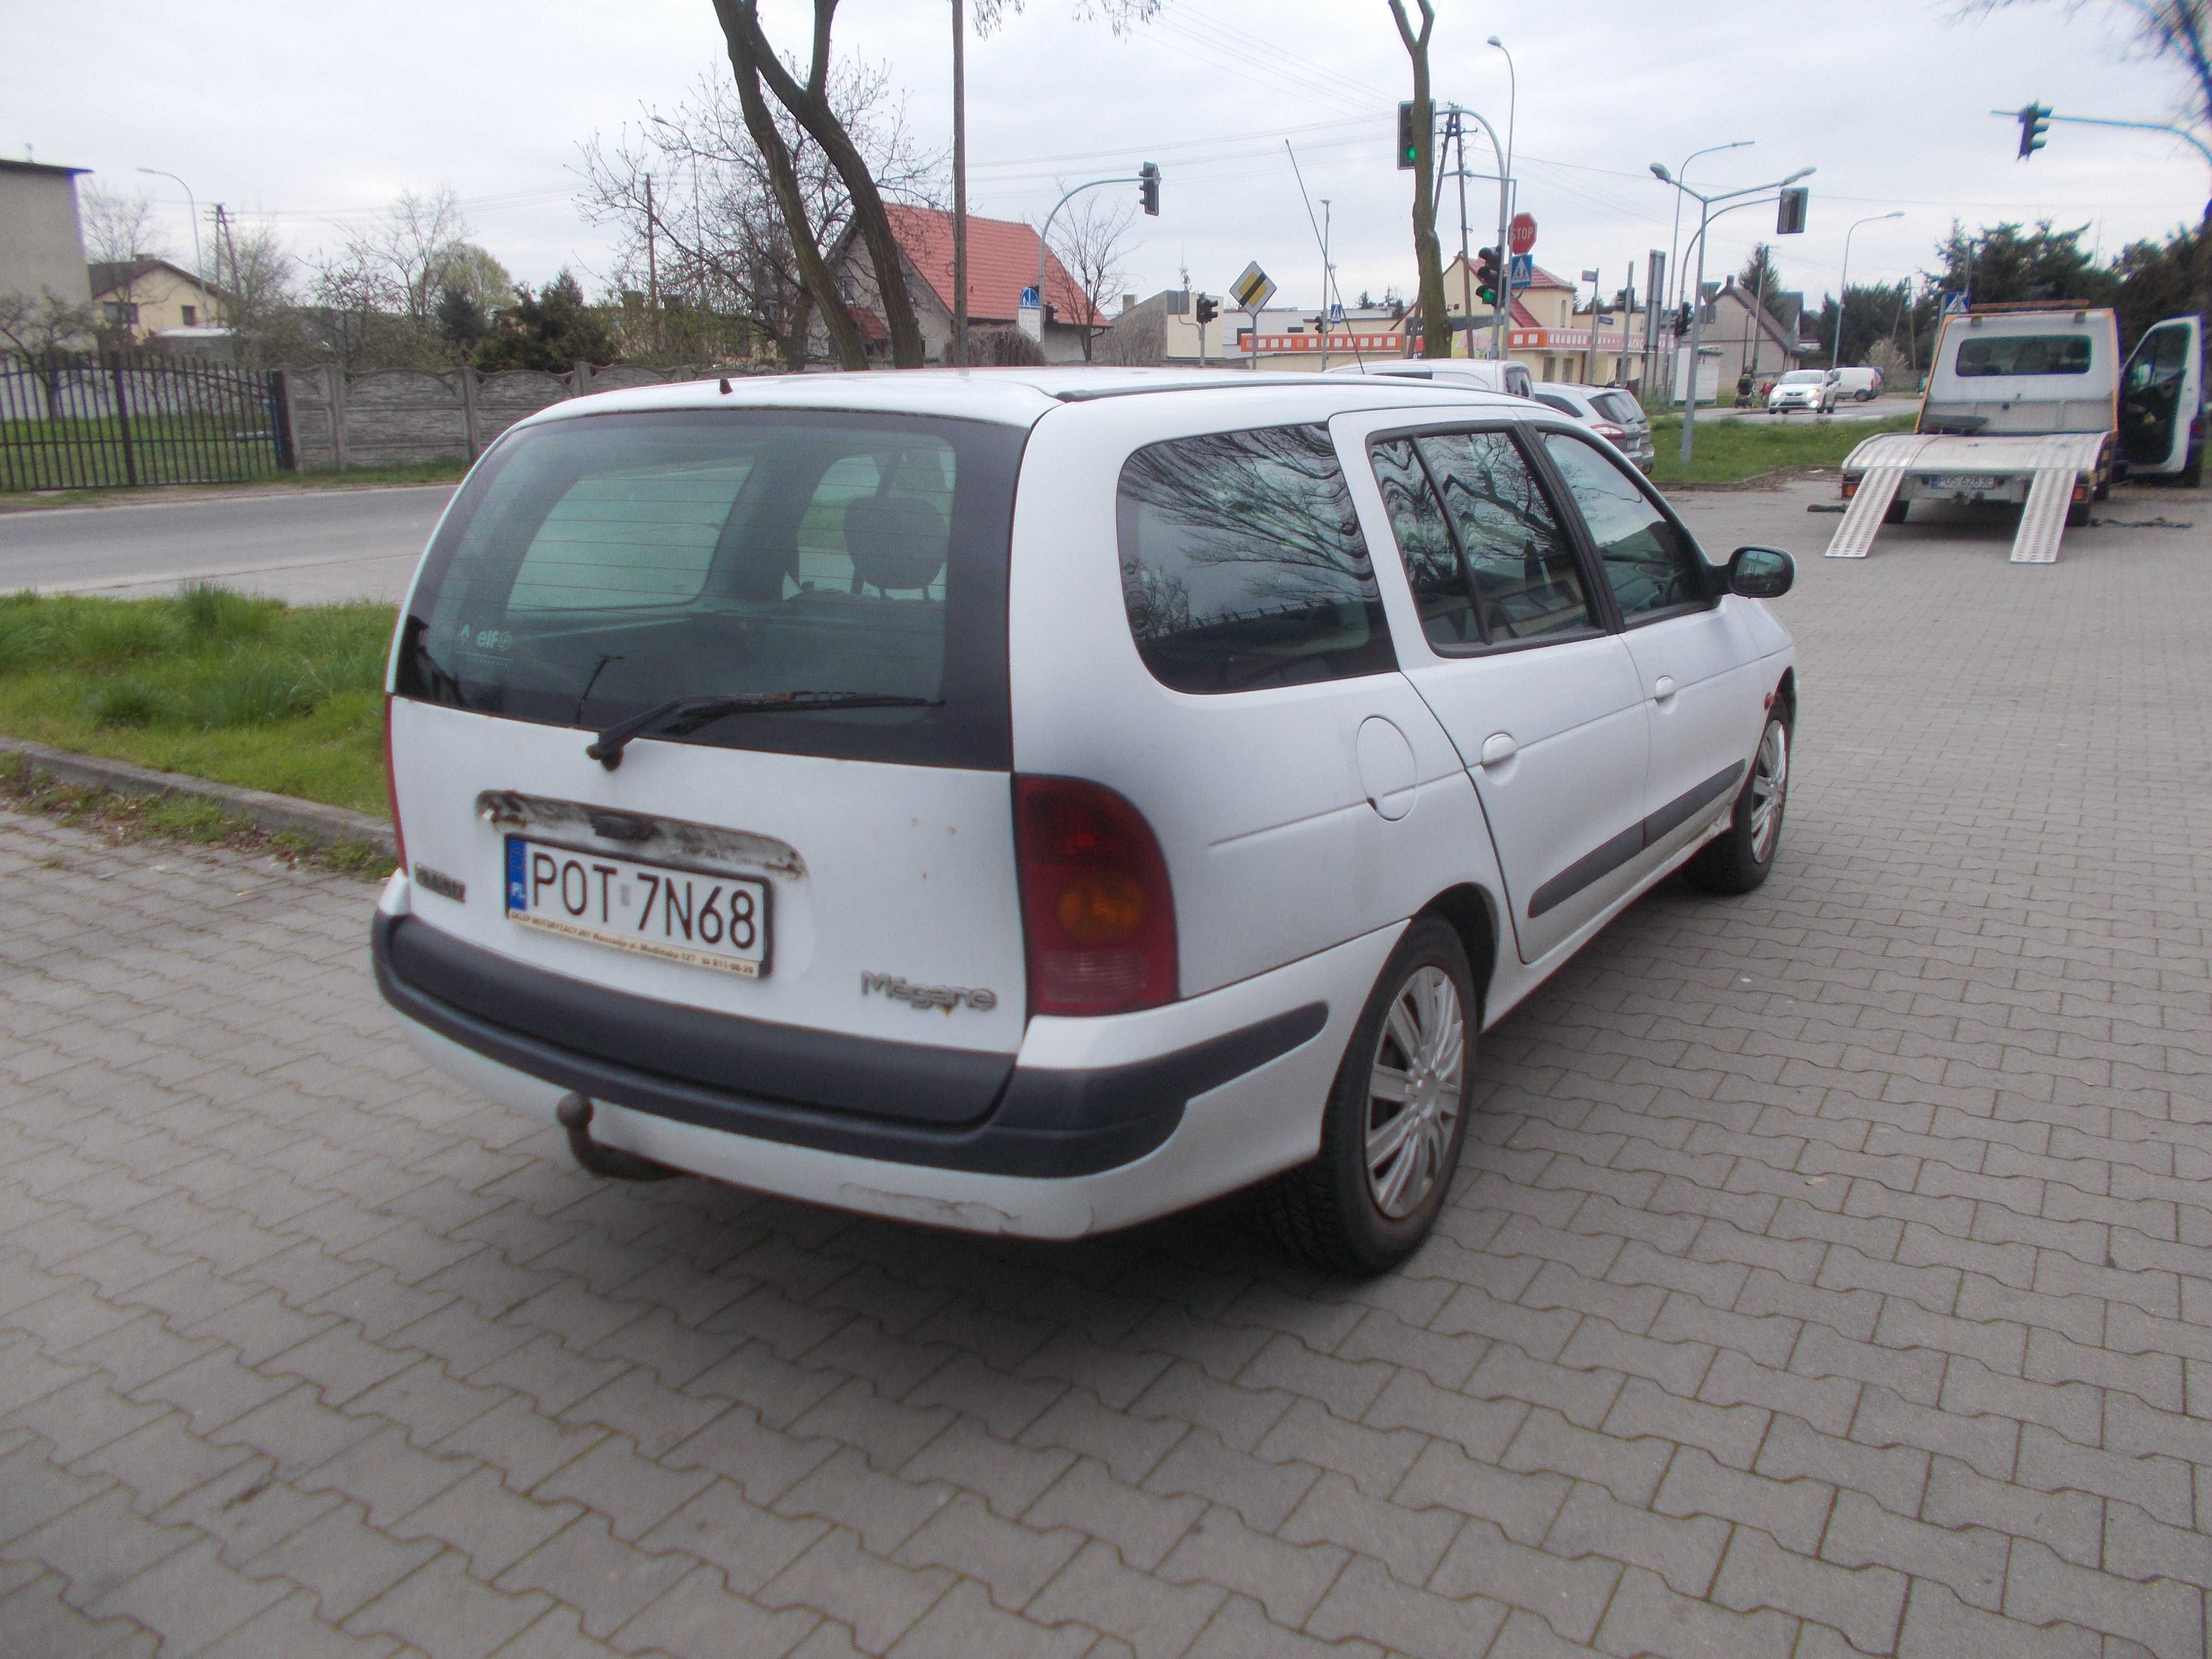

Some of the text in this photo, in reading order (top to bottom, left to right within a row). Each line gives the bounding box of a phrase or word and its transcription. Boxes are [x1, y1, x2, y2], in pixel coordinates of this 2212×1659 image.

[1512, 226, 1533, 240] STOP
[533, 852, 618, 923] POT
[637, 871, 756, 950] 7N68
